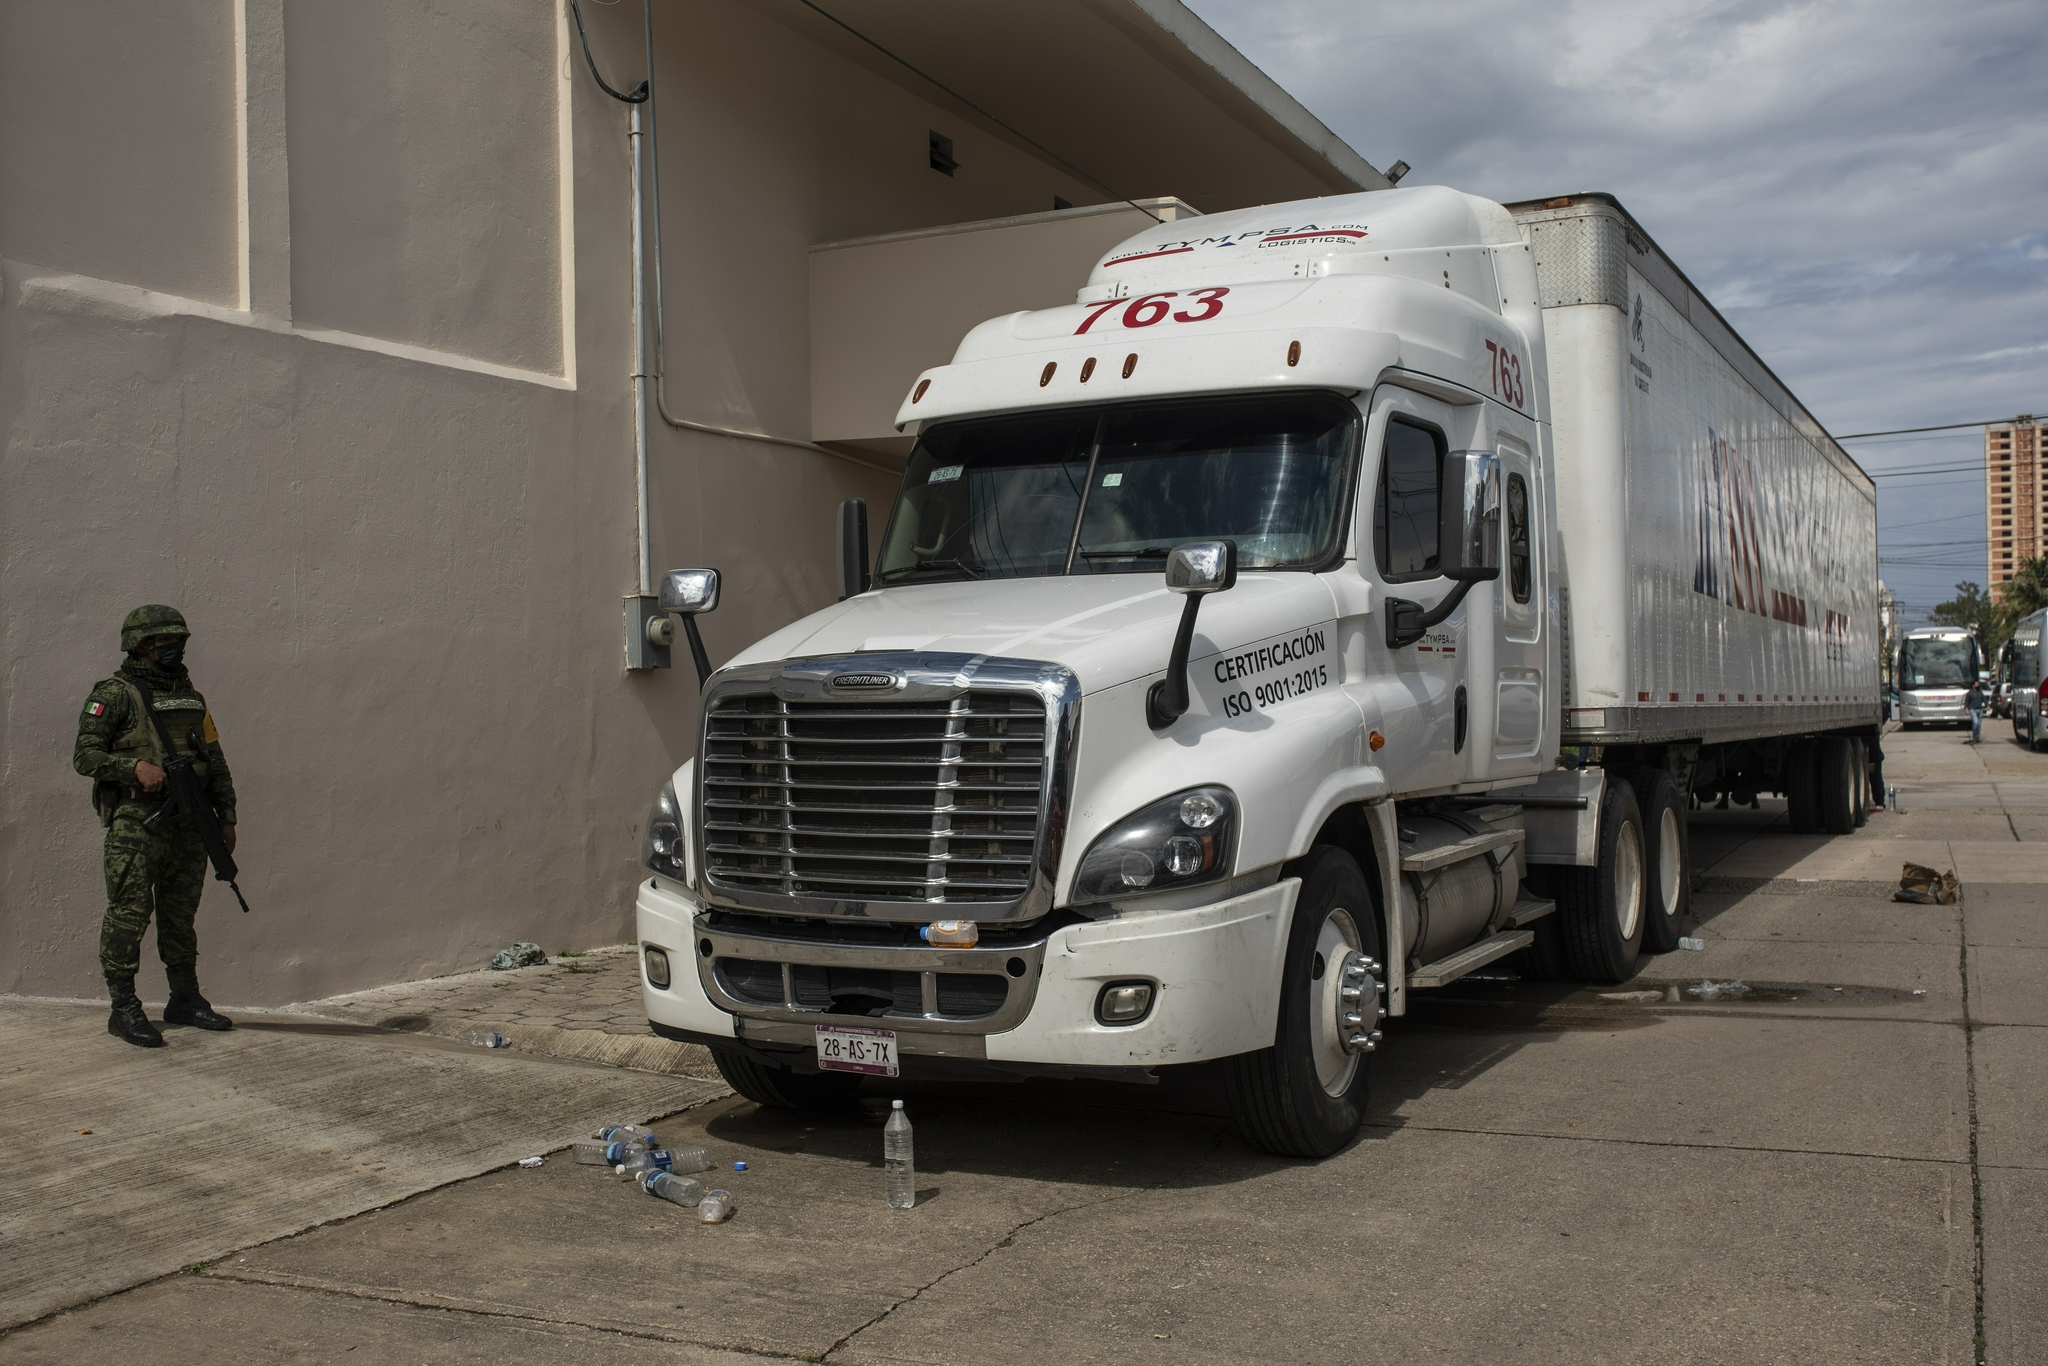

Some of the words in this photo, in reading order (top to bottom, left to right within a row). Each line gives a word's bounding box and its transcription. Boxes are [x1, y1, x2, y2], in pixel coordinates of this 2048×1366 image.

[1258, 236, 1347, 249] LOGISTICS
[1073, 287, 1231, 336] 763
[1485, 338, 1524, 409] 763
[834, 676, 889, 685] FREIGHTLINER
[1214, 628, 1326, 684] CERTIFICACIÓN
[1222, 691, 1252, 719] ISO
[1255, 664, 1328, 709] 9001:2015
[823, 1037, 889, 1063] 28-AS-7X
